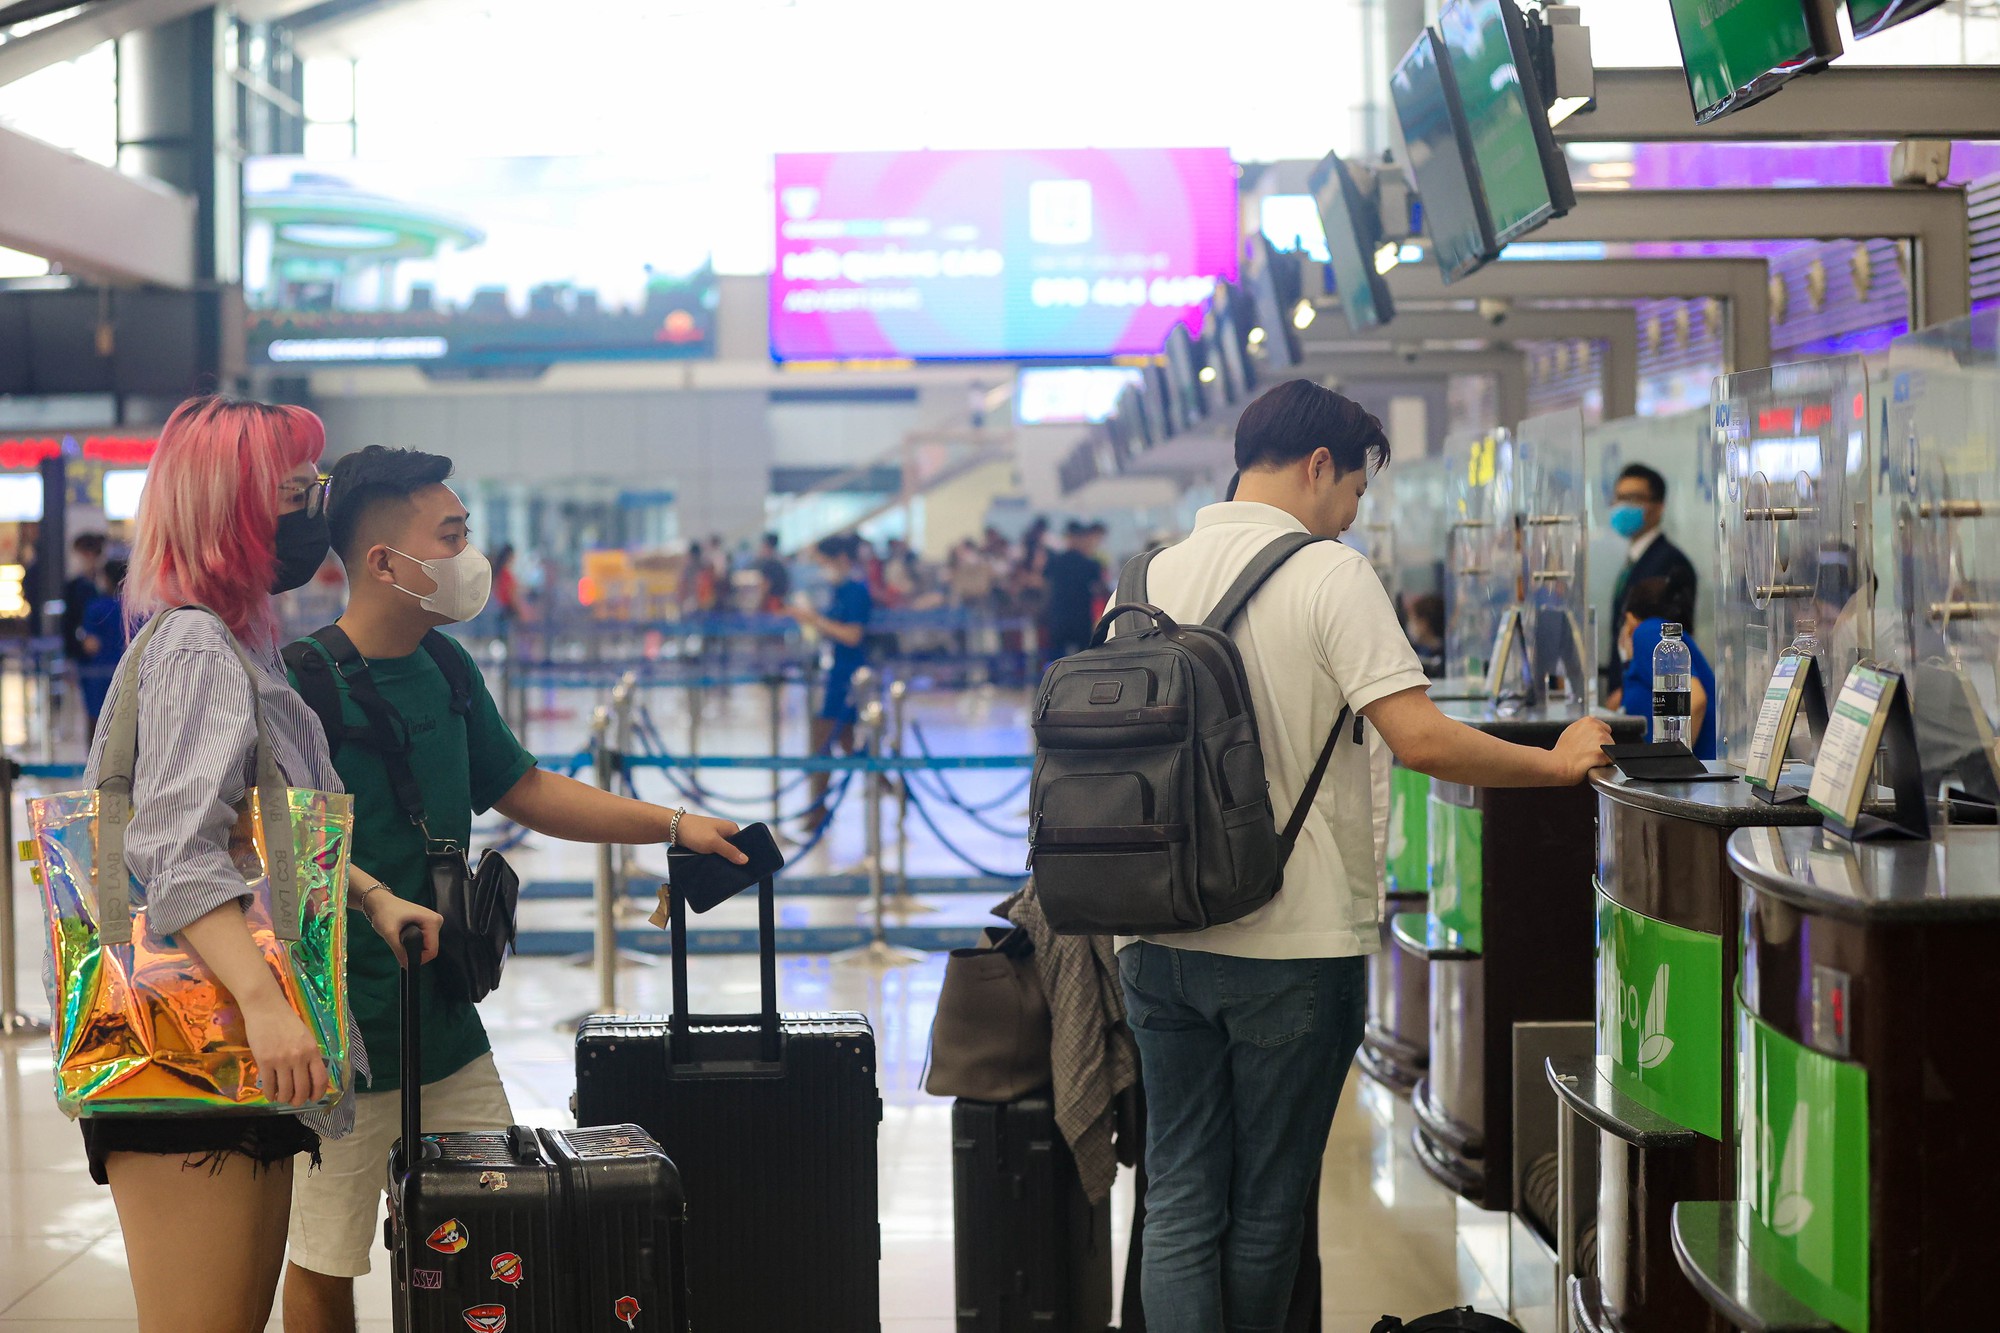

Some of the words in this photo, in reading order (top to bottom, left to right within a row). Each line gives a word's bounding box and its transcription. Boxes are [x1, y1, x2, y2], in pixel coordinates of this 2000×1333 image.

[1715, 403, 1730, 428] ACV
[106, 852, 121, 890] LAAB
[275, 850, 290, 882] BOO
[278, 889, 294, 929] LAAB
